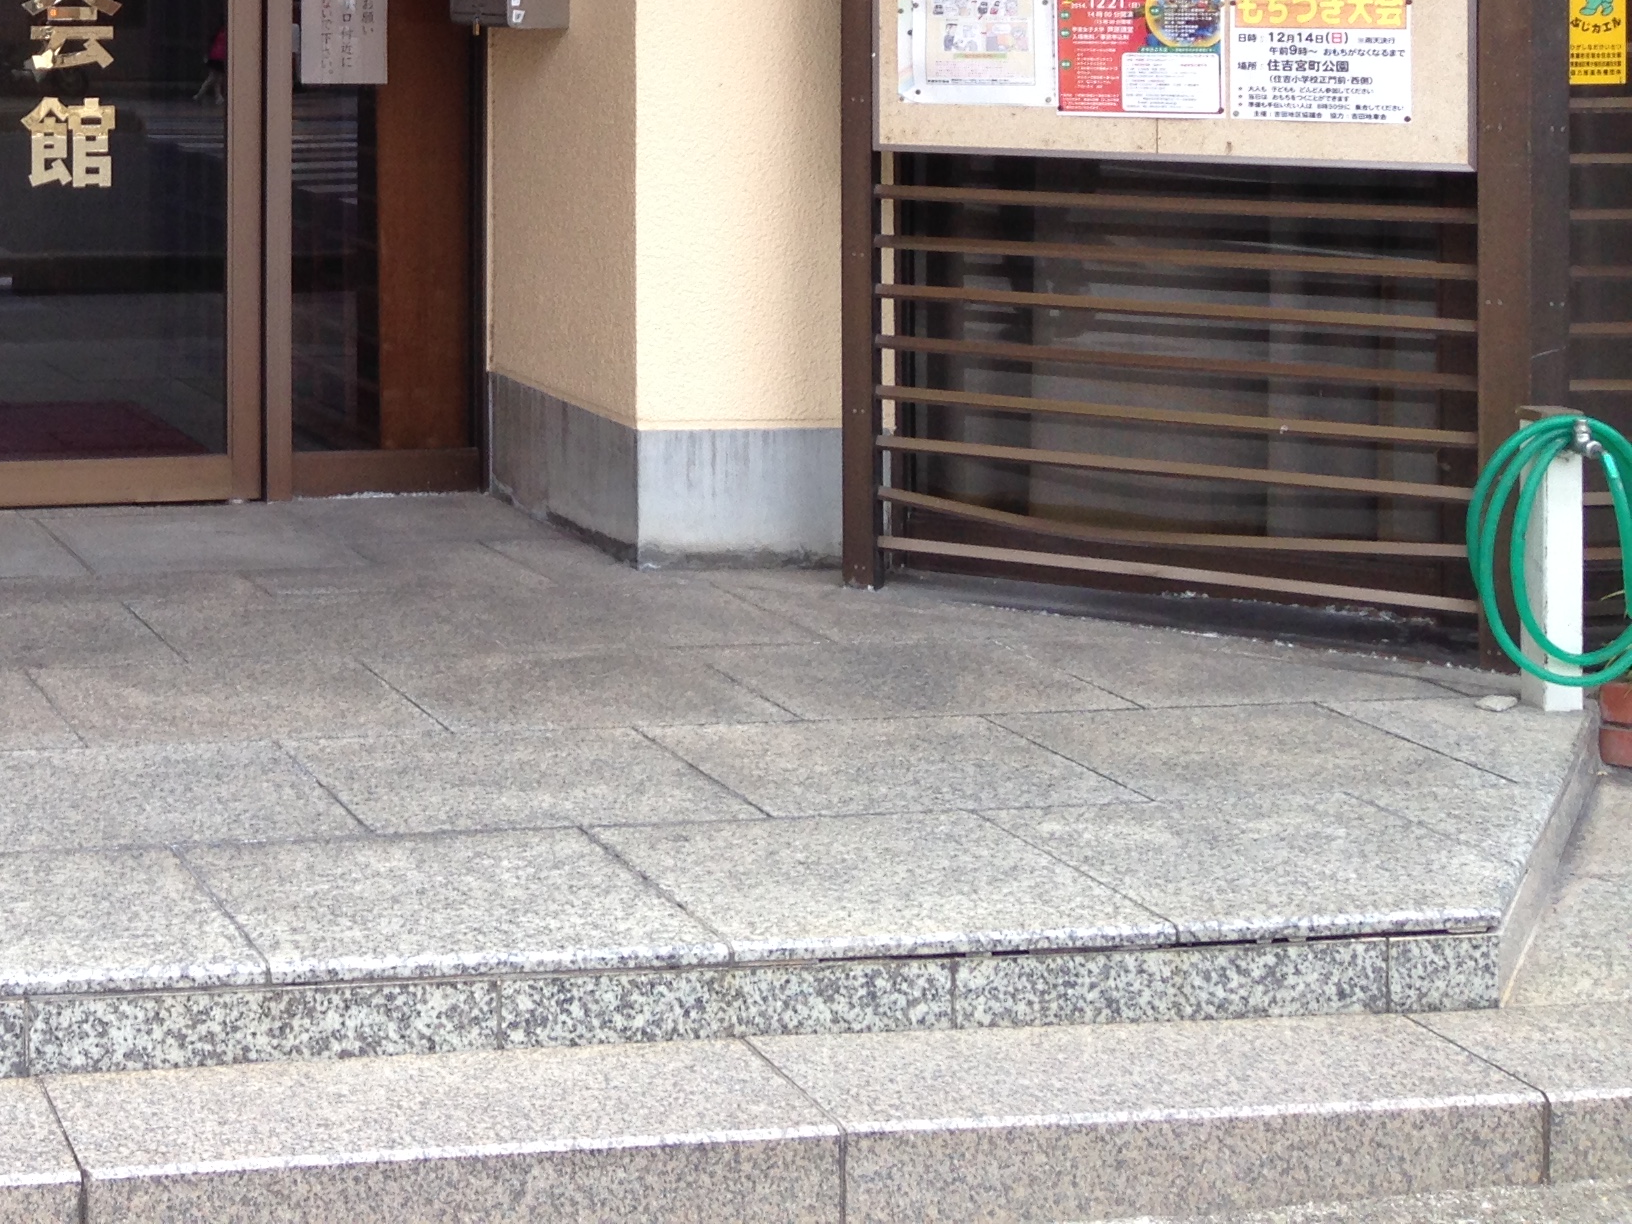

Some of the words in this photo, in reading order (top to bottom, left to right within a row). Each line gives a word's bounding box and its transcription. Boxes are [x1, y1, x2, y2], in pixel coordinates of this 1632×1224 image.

[1268, 31, 1349, 44] 12月14日(日)
[1323, 48, 1406, 57] おもちがなくなるまで
[1267, 59, 1350, 73] 住吉宮町公園
